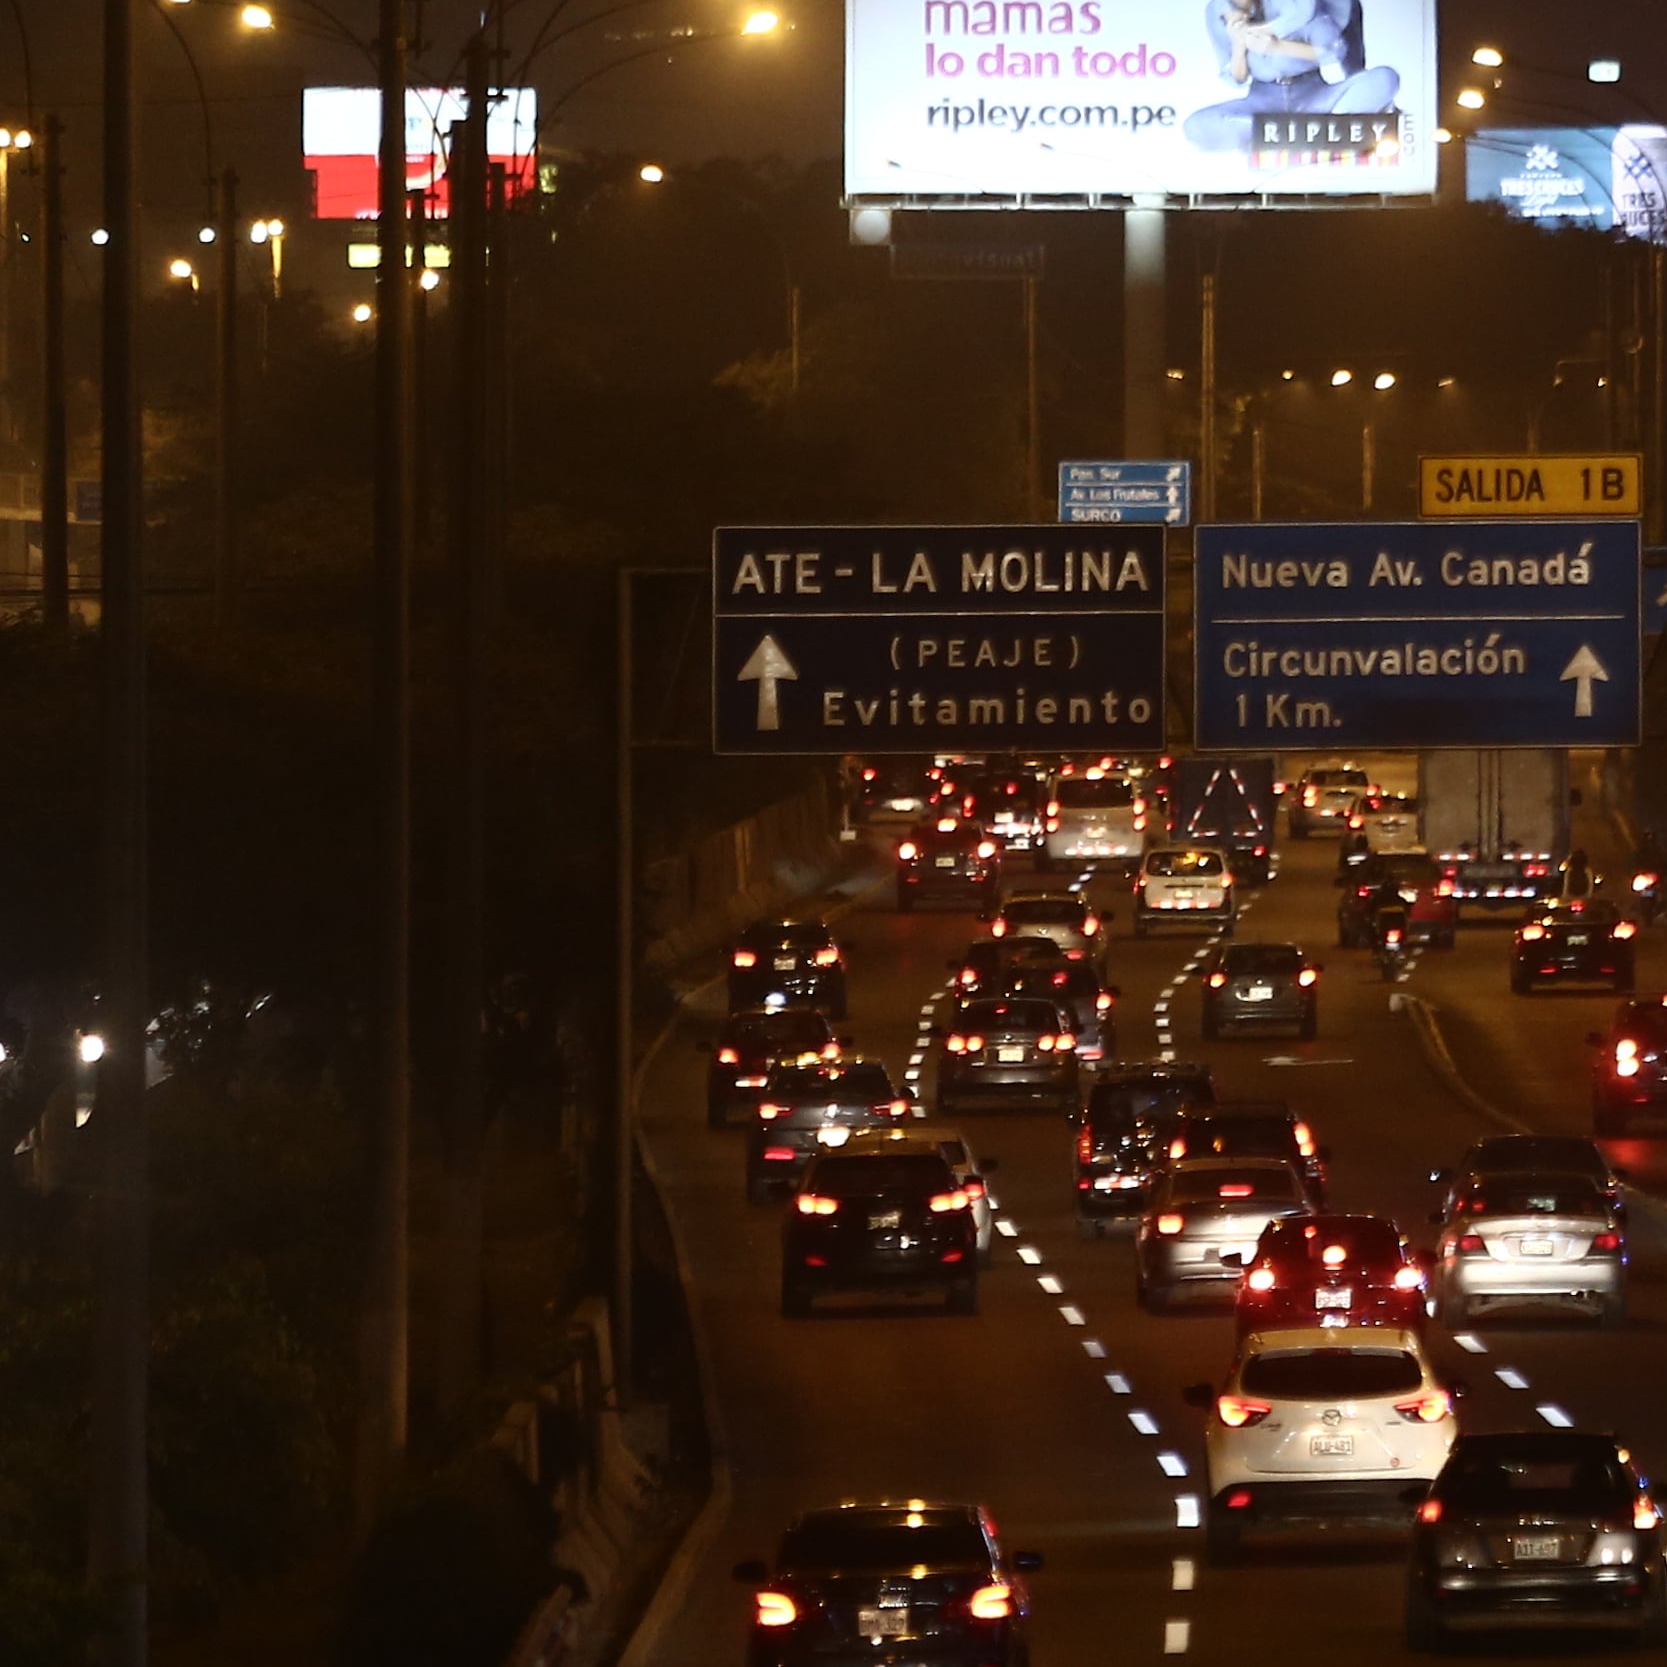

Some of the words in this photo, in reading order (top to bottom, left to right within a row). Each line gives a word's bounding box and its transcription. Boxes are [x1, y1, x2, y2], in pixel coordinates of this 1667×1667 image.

[925, 43, 964, 78] lo
[976, 43, 1060, 78] dan
[1072, 43, 1177, 78] todo
[927, 98, 1177, 132] ripley.com.pe
[1263, 120, 1388, 143] RIPLEY
[1436, 468, 1546, 503] SALIDA
[1072, 508, 1121, 523] SURCO
[732, 552, 822, 595] ATE
[872, 552, 938, 594] LA
[961, 550, 1149, 593] MOLINA
[1221, 553, 1350, 589] Nueva
[1368, 552, 1424, 587] Av.
[1440, 541, 1594, 586] Canadá
[1223, 633, 1527, 678] Circunvalación
[822, 689, 1152, 727] Evitamiento
[1235, 693, 1247, 728] 1
[1266, 692, 1343, 728] Km.
